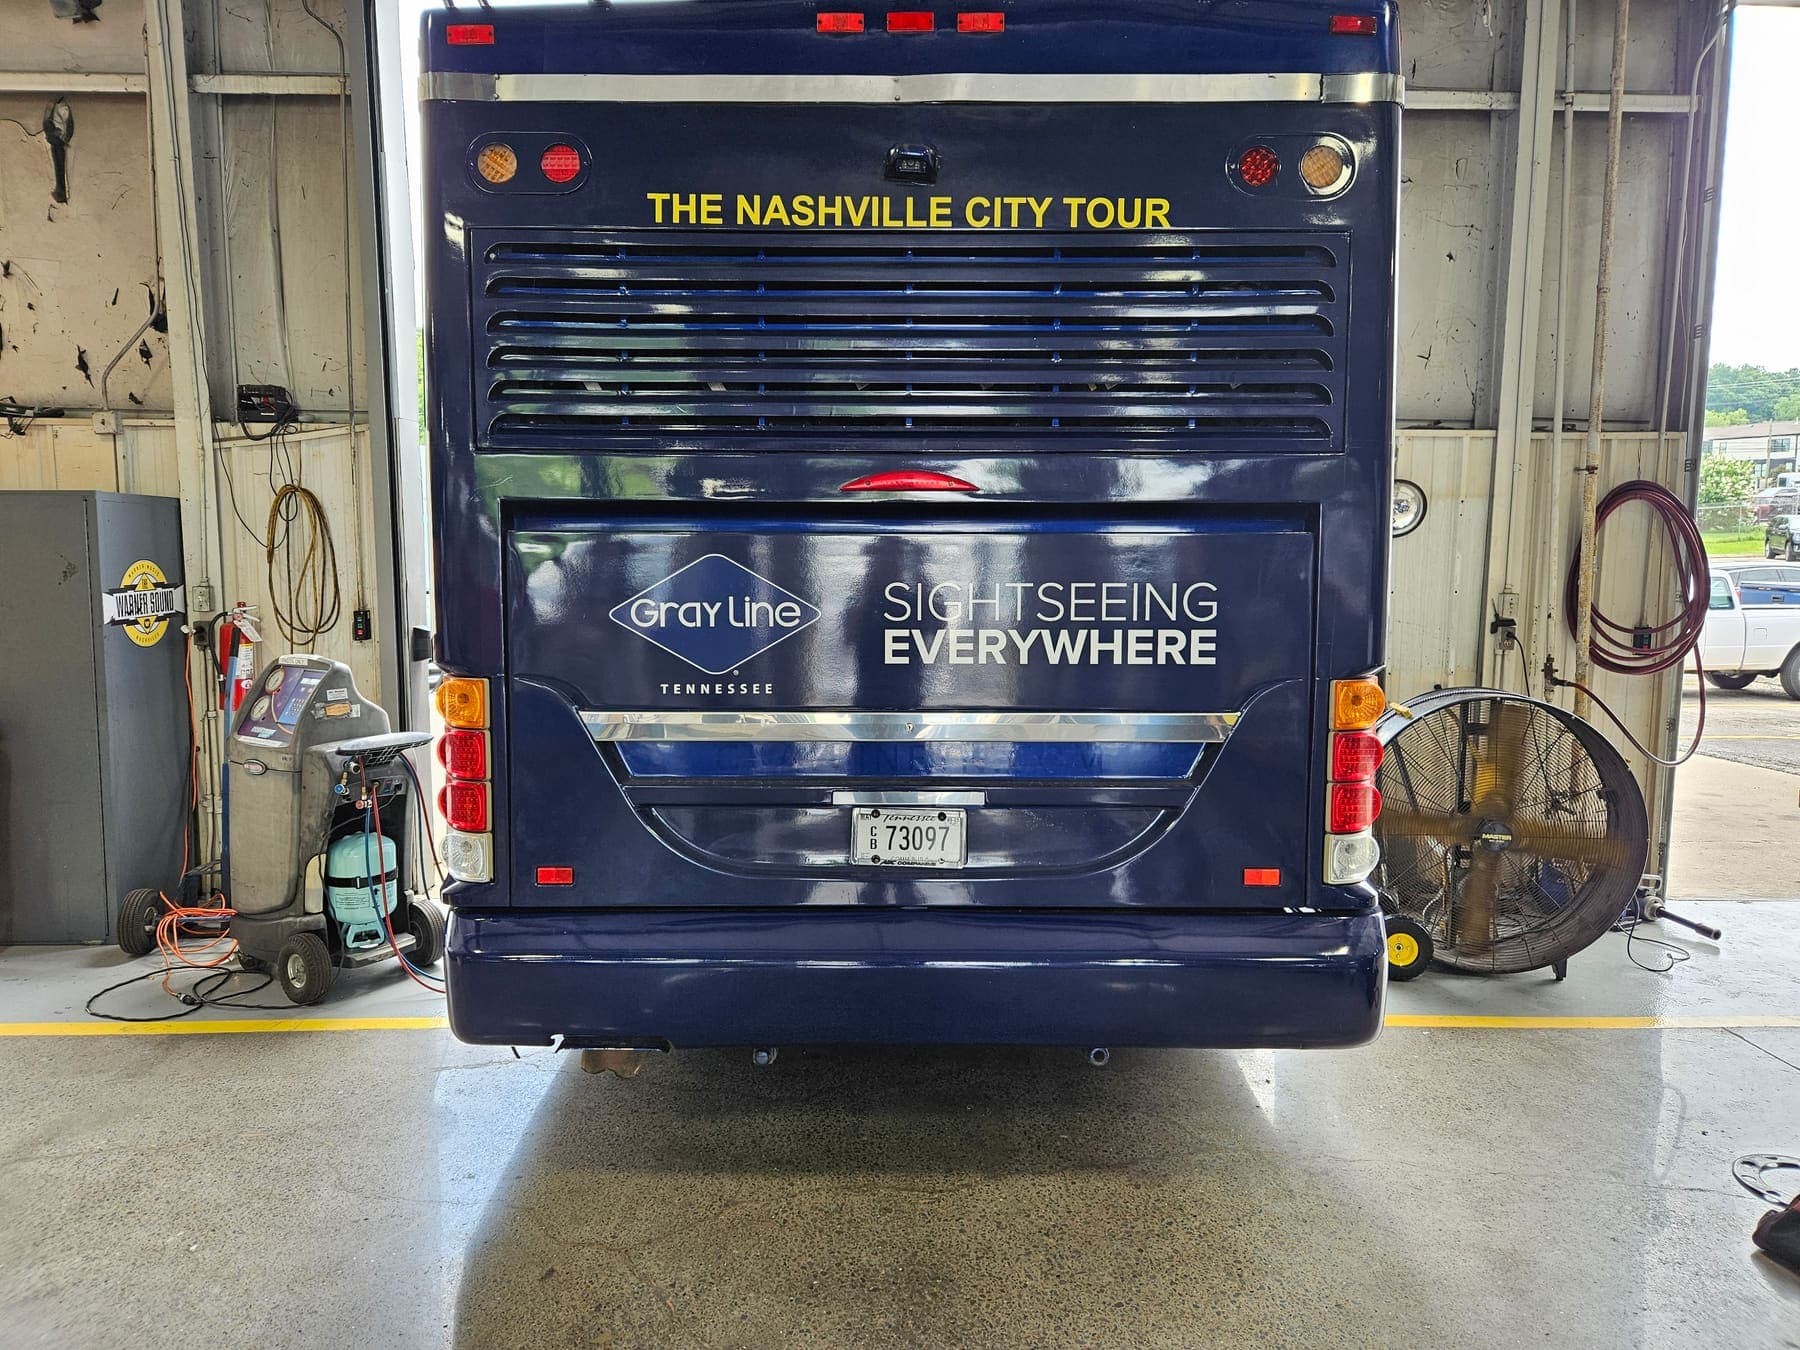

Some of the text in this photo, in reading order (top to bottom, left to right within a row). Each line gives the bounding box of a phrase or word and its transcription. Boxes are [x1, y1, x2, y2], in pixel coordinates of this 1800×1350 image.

[647, 193, 1171, 228] THE NASHVILLE CITY TOUR
[115, 590, 174, 617] WARNER SOUND
[630, 596, 801, 628] Gray Line
[883, 582, 1218, 622] SIGHTSEEING
[884, 629, 1216, 665] EVERYWHERE
[660, 683, 773, 695] TENNESSEE
[870, 826, 877, 837] C
[870, 839, 877, 850] B
[886, 825, 950, 851] 73097
